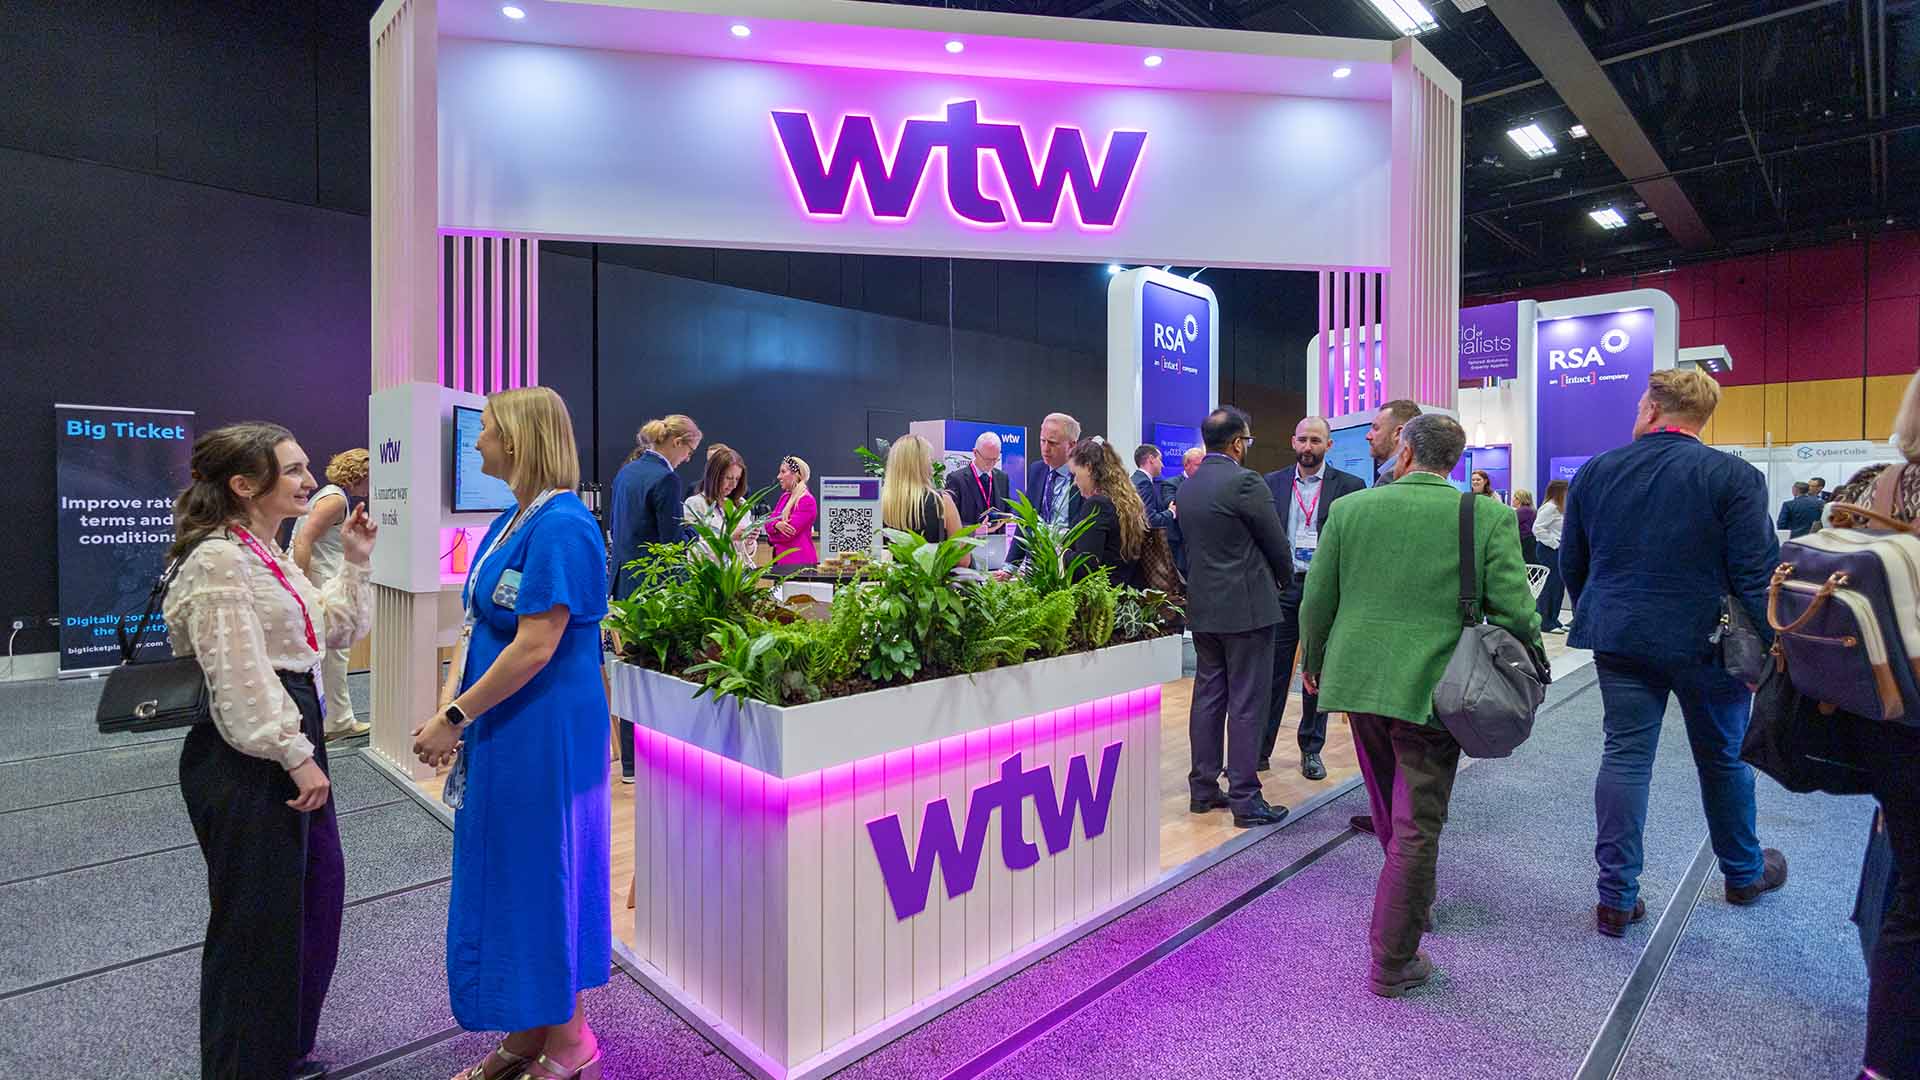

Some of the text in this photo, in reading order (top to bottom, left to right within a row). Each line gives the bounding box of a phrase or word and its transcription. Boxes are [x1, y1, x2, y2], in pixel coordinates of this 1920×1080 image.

[770, 99, 1148, 226] wtw
[1154, 322, 1186, 353] RSA
[1461, 336, 1511, 354] ialists
[1549, 346, 1605, 371] RSA
[66, 420, 185, 440] Big Ticket
[1001, 433, 1020, 444] wtw
[379, 438, 401, 464] wtw
[62, 496, 142, 511] Improve
[80, 514, 174, 527] terms and
[66, 615, 121, 628] Digitally
[92, 627, 116, 637] the
[865, 741, 1123, 922] wtw
